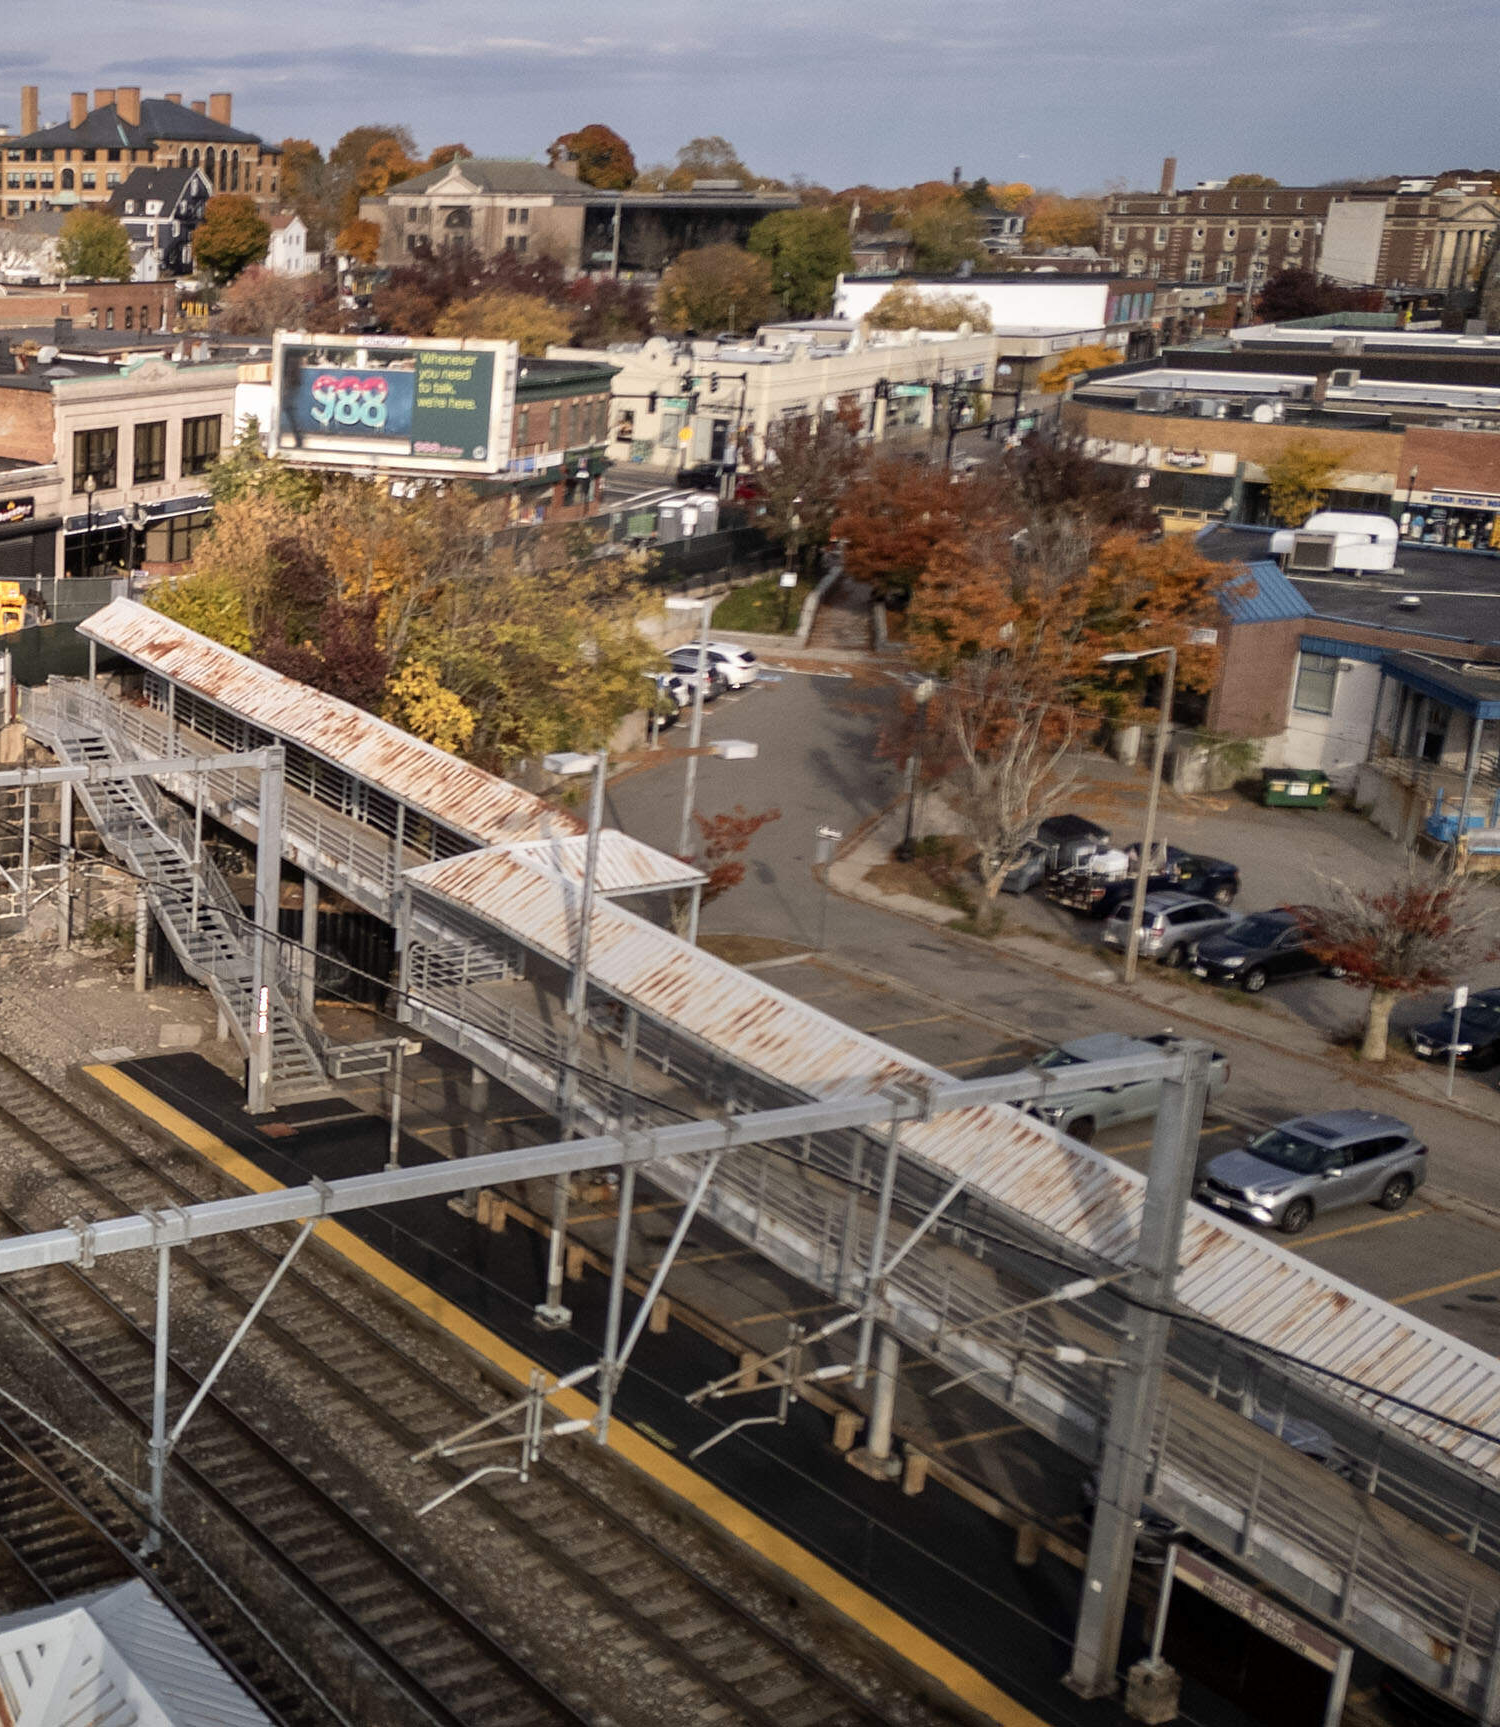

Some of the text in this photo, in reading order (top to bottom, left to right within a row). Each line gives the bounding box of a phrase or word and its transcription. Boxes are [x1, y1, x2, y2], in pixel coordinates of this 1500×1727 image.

[420, 352, 478, 366] Whenever
[419, 368, 472, 381] you need
[419, 382, 431, 393] to
[311, 375, 388, 428] 988
